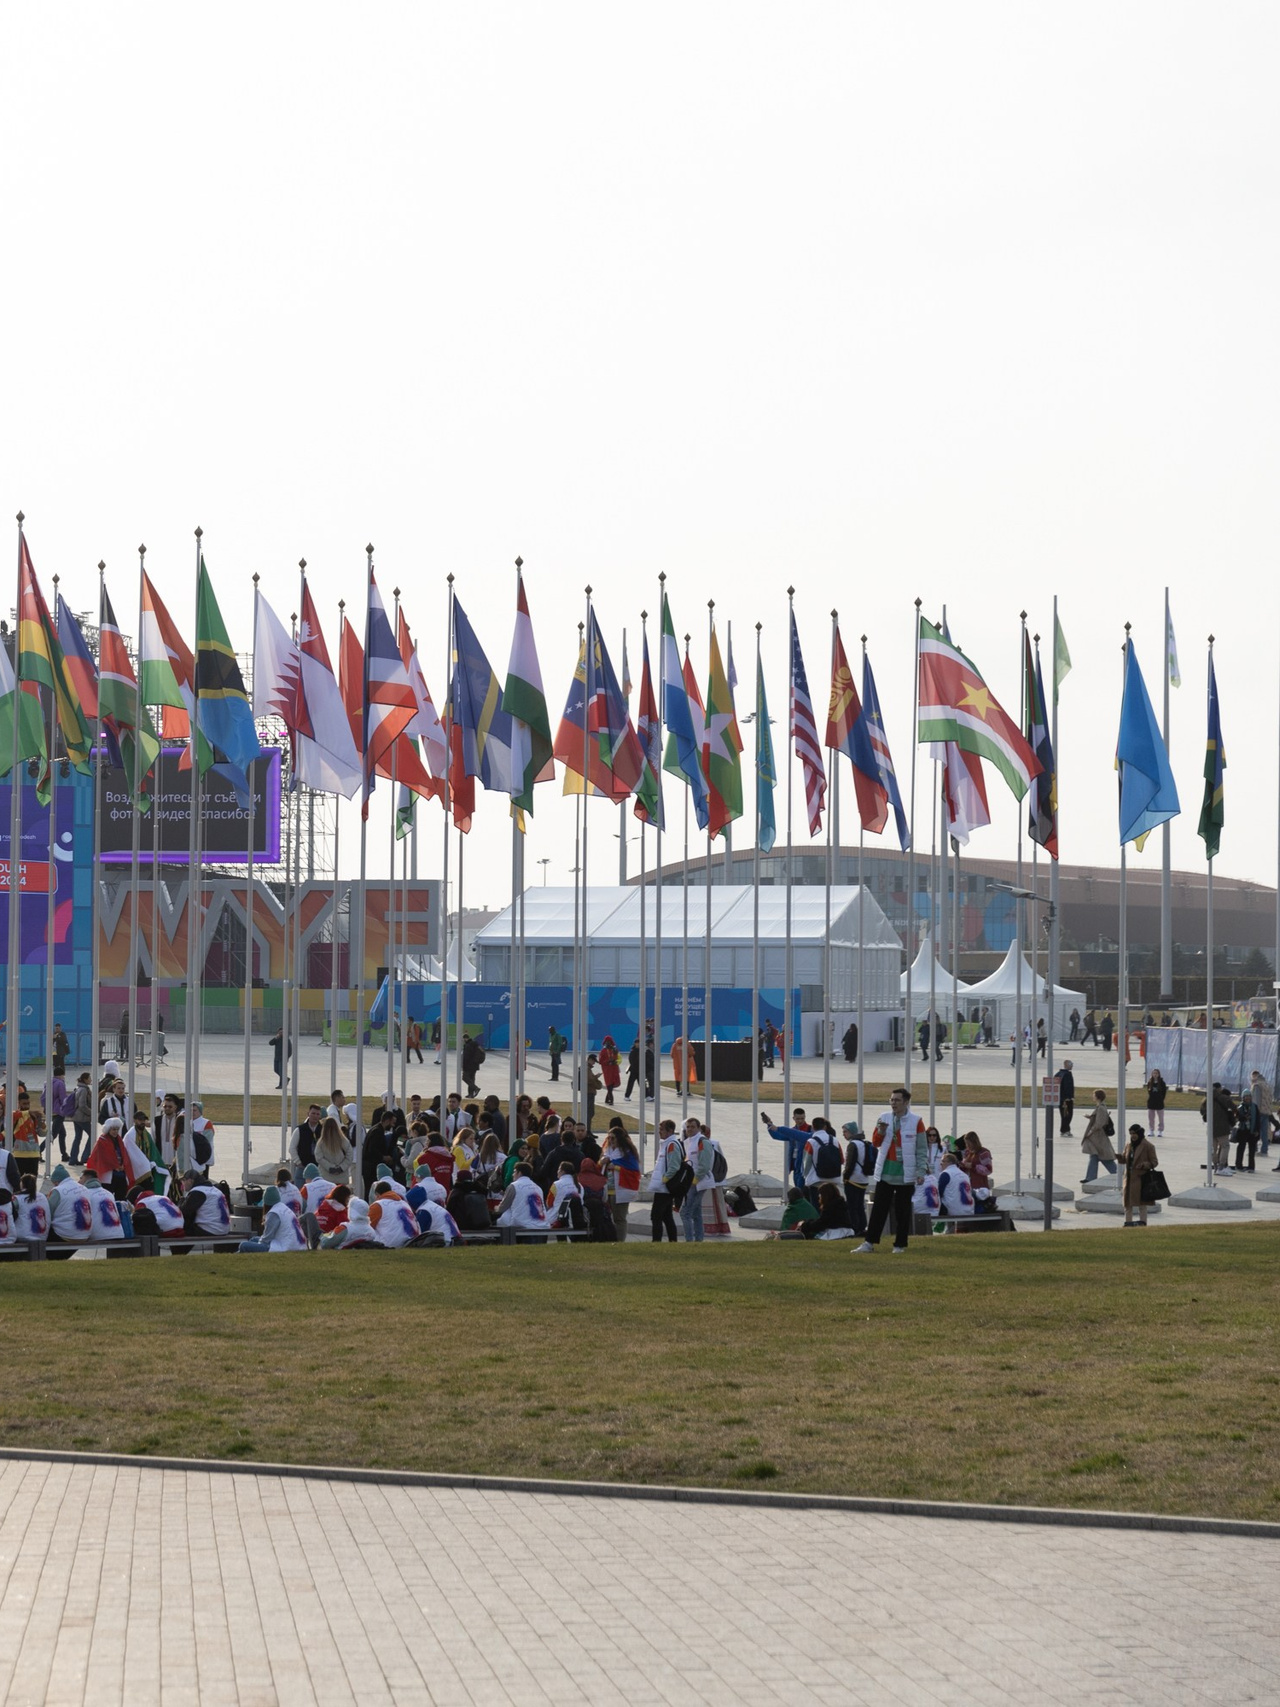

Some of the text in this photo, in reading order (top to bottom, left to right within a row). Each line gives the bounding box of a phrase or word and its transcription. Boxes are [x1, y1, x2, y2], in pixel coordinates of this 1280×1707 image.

[106, 791, 193, 805] Возджитесь
[214, 791, 261, 803] съёи
[110, 807, 140, 822] фот
[143, 810, 151, 819] и
[0, 875, 27, 886] 204
